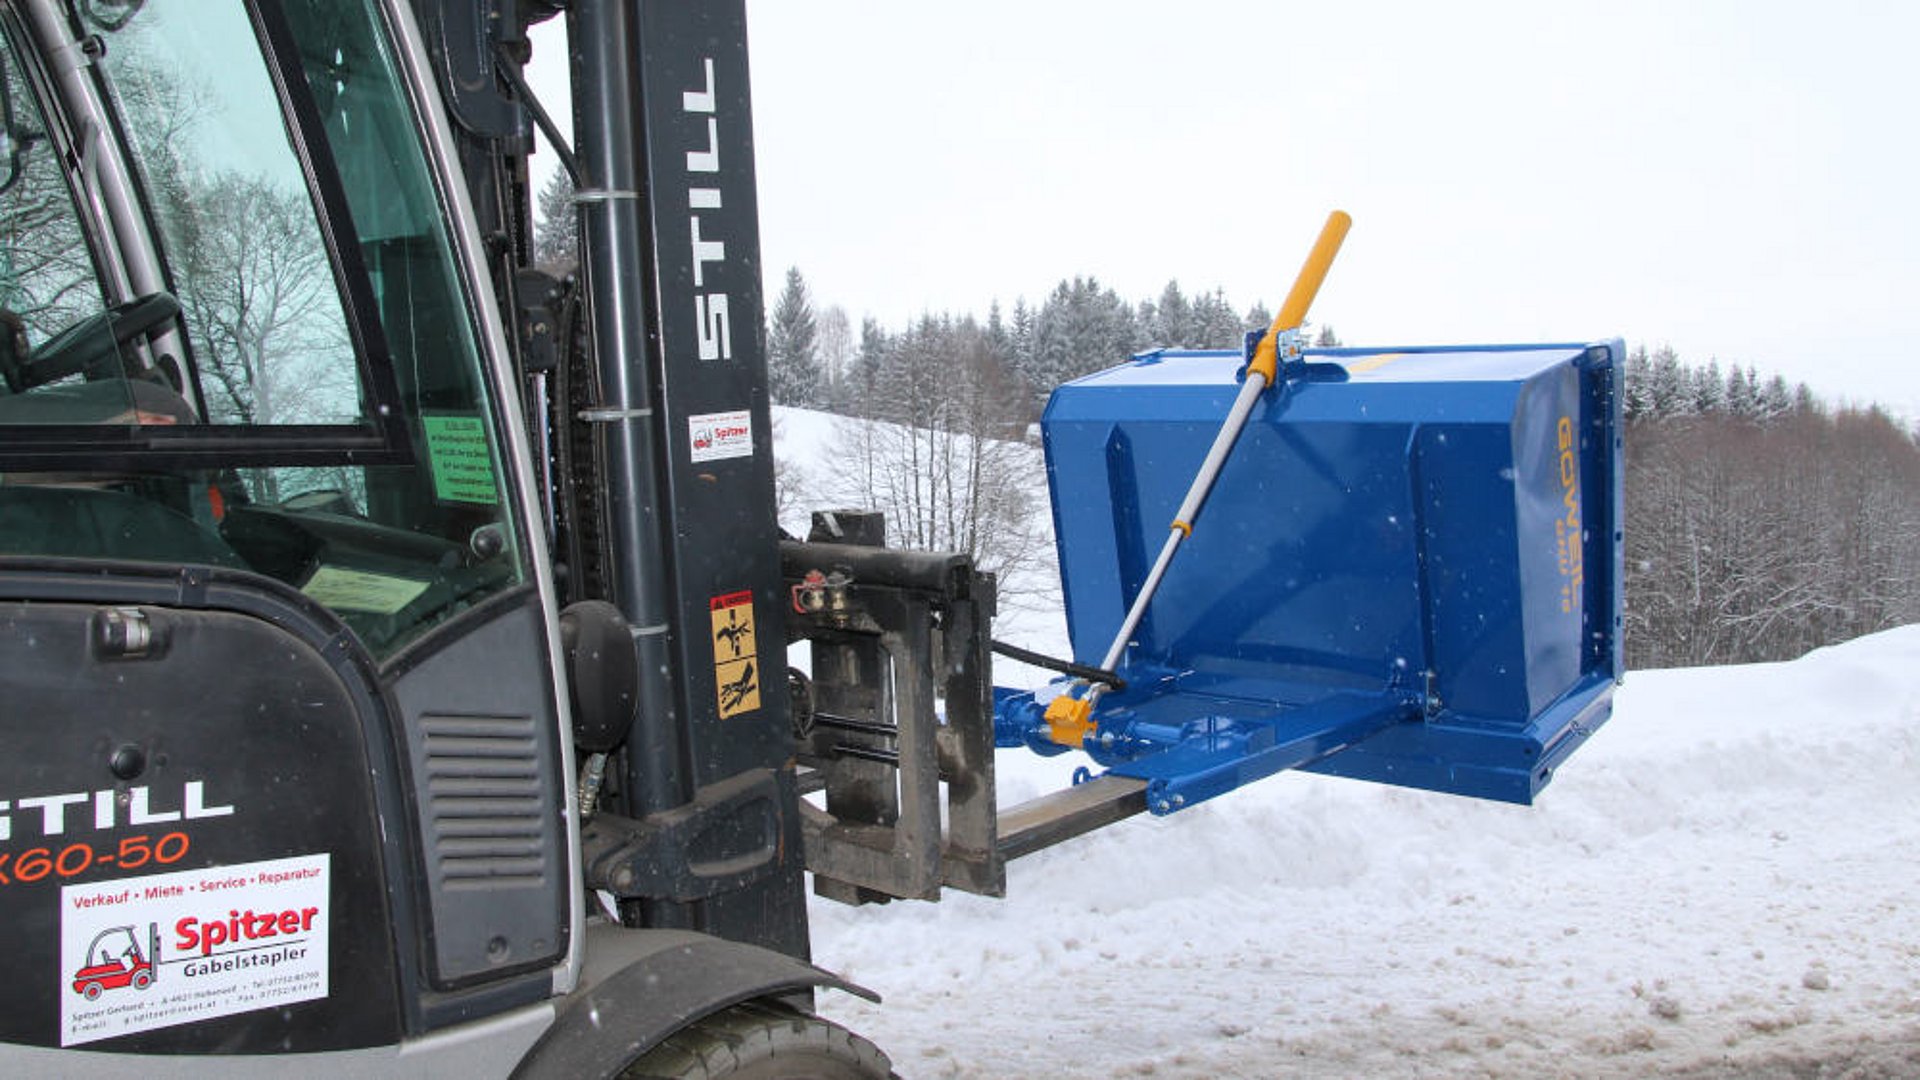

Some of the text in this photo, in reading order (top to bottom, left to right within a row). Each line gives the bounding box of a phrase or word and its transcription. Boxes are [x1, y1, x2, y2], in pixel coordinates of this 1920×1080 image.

[683, 58, 731, 360] STILL
[0, 781, 234, 840] TILL
[74, 867, 321, 909] Verkauf Miete Service Reparatur
[175, 906, 319, 956] Spitzer
[183, 947, 308, 977] Gabelstapler
